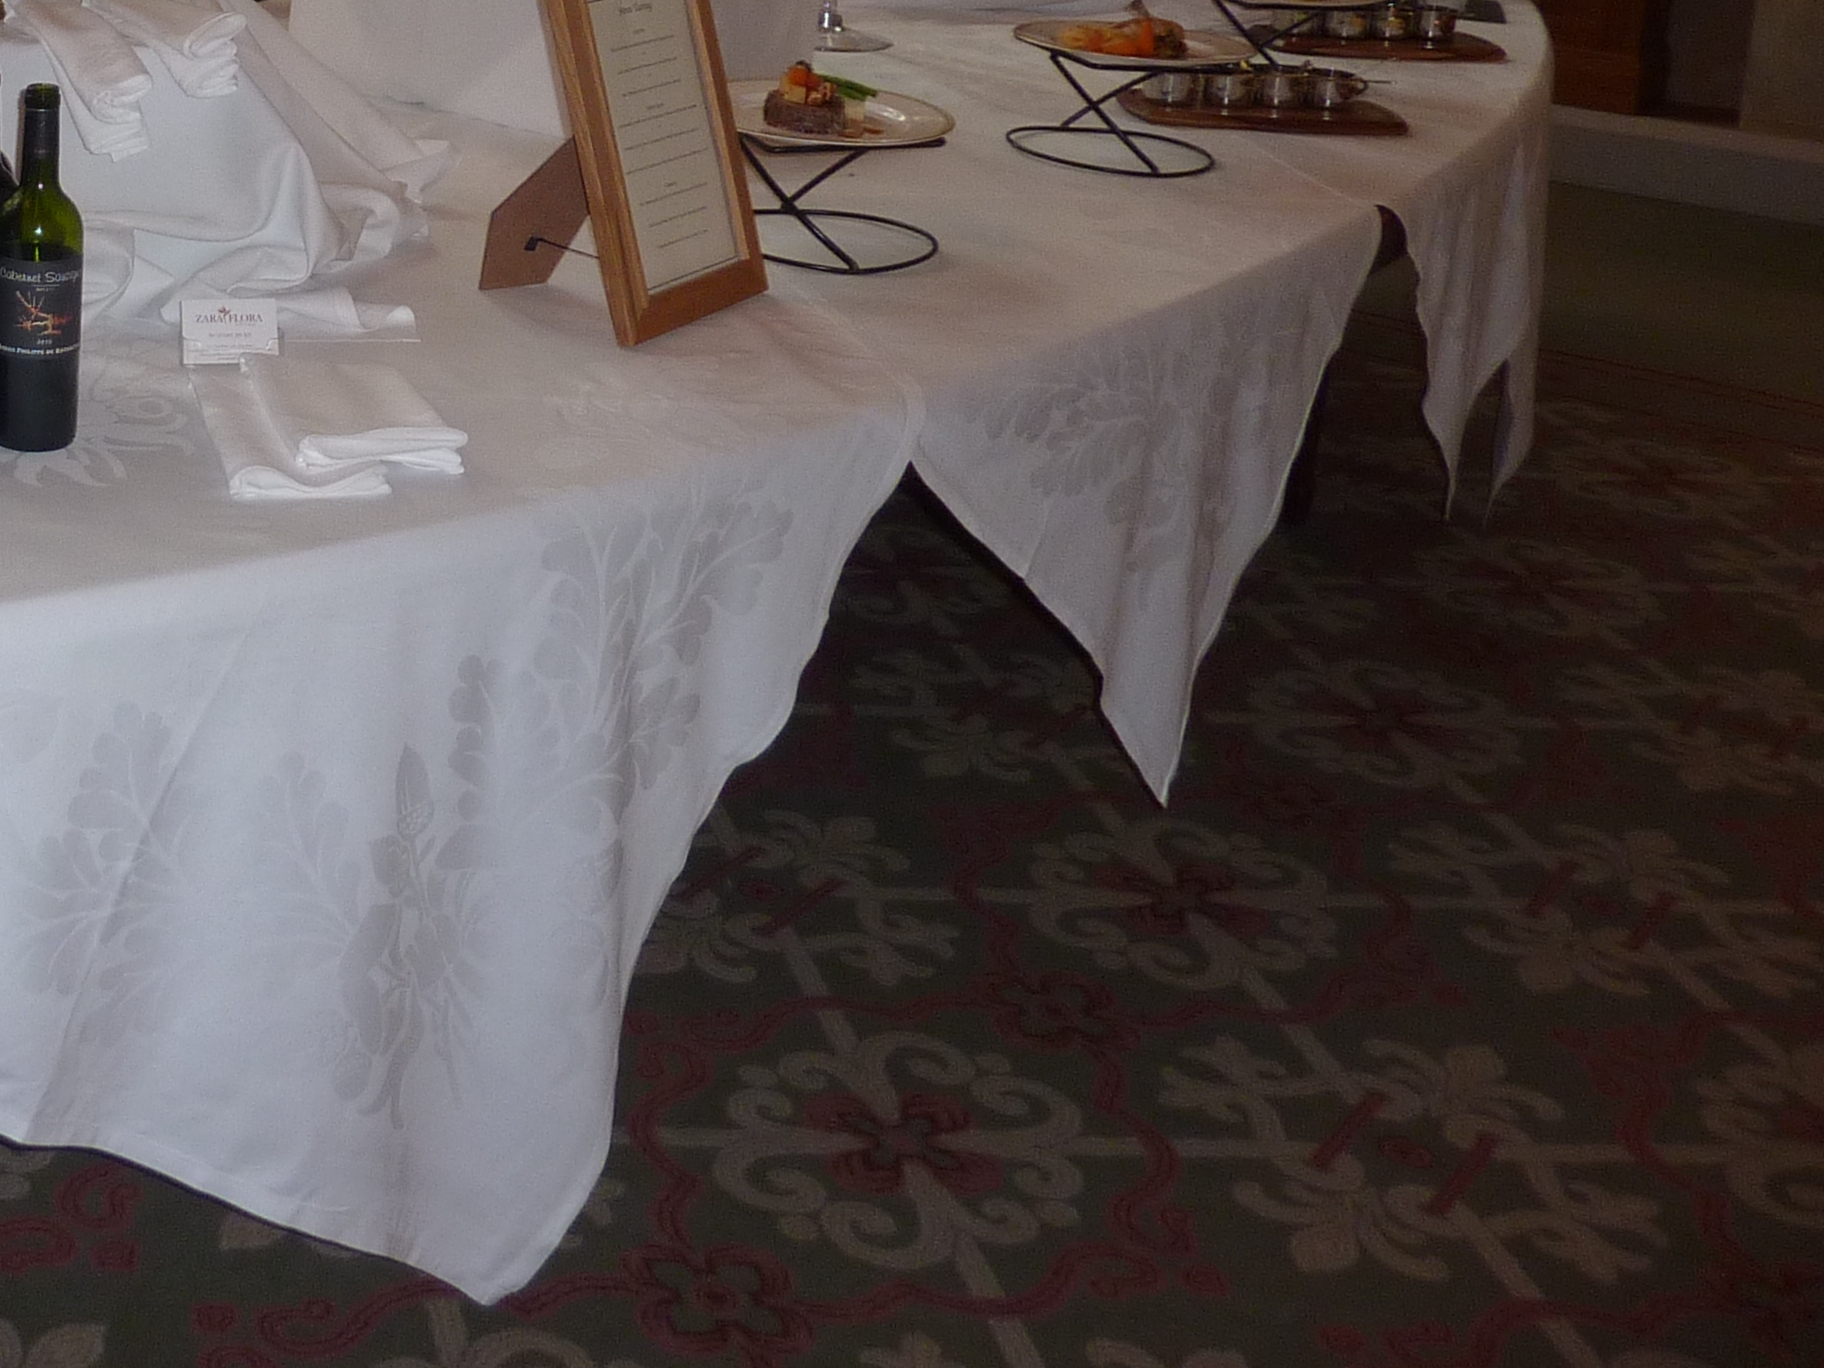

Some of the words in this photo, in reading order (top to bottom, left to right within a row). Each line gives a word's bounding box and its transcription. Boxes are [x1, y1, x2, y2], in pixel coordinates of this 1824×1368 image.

[0, 267, 42, 283] Cabernet
[195, 313, 223, 324] ZARA
[228, 313, 263, 324] FLORA
